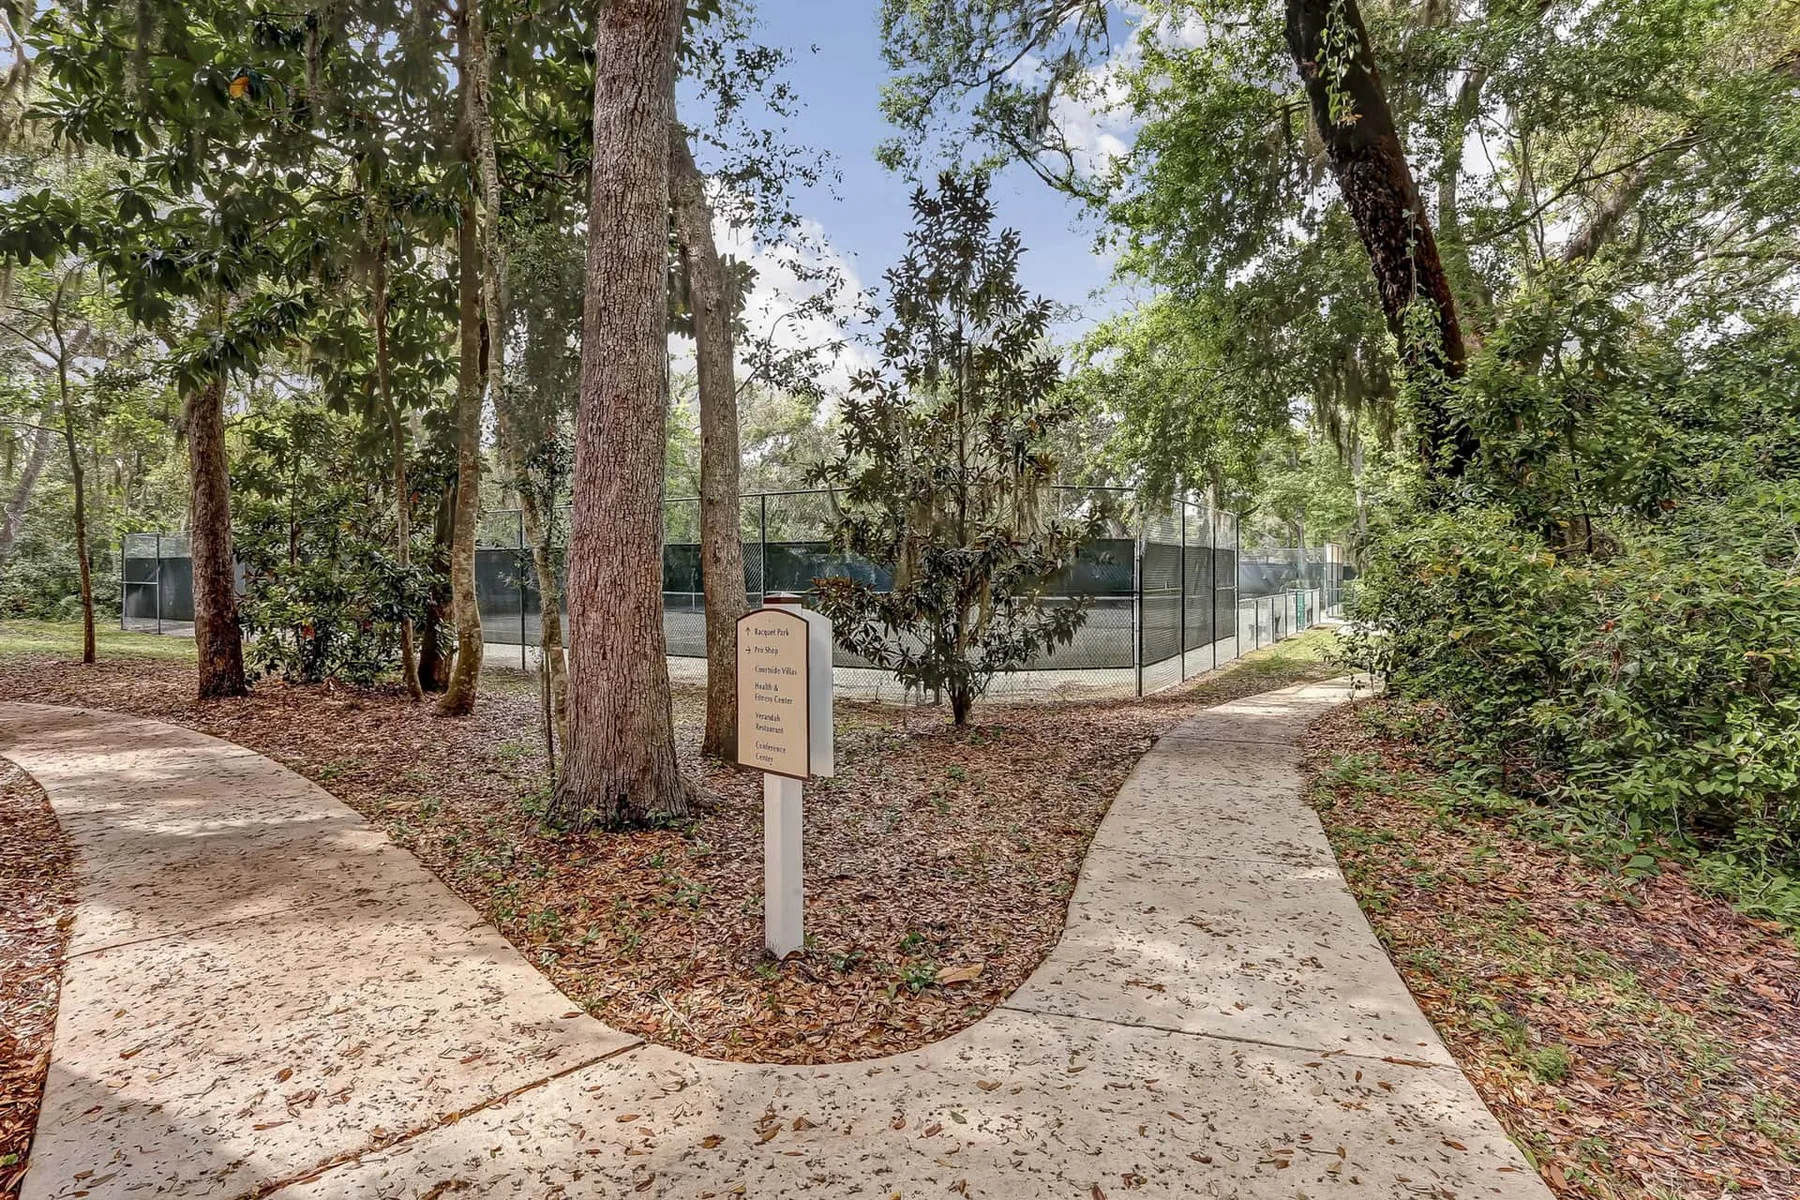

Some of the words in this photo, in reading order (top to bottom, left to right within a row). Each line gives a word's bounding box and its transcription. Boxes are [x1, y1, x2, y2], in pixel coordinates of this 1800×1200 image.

[754, 628, 776, 638] Racquet
[777, 628, 789, 636] Park
[754, 646, 763, 654] Pro
[765, 646, 778, 656] Shop
[781, 667, 797, 675] Villas
[754, 682, 772, 691] Health
[754, 693, 773, 703] Fitness
[774, 695, 793, 704] Center
[755, 712, 780, 721] Verandah
[756, 723, 784, 734] Restaurant
[756, 741, 786, 753] Conference
[756, 753, 773, 762] Center
